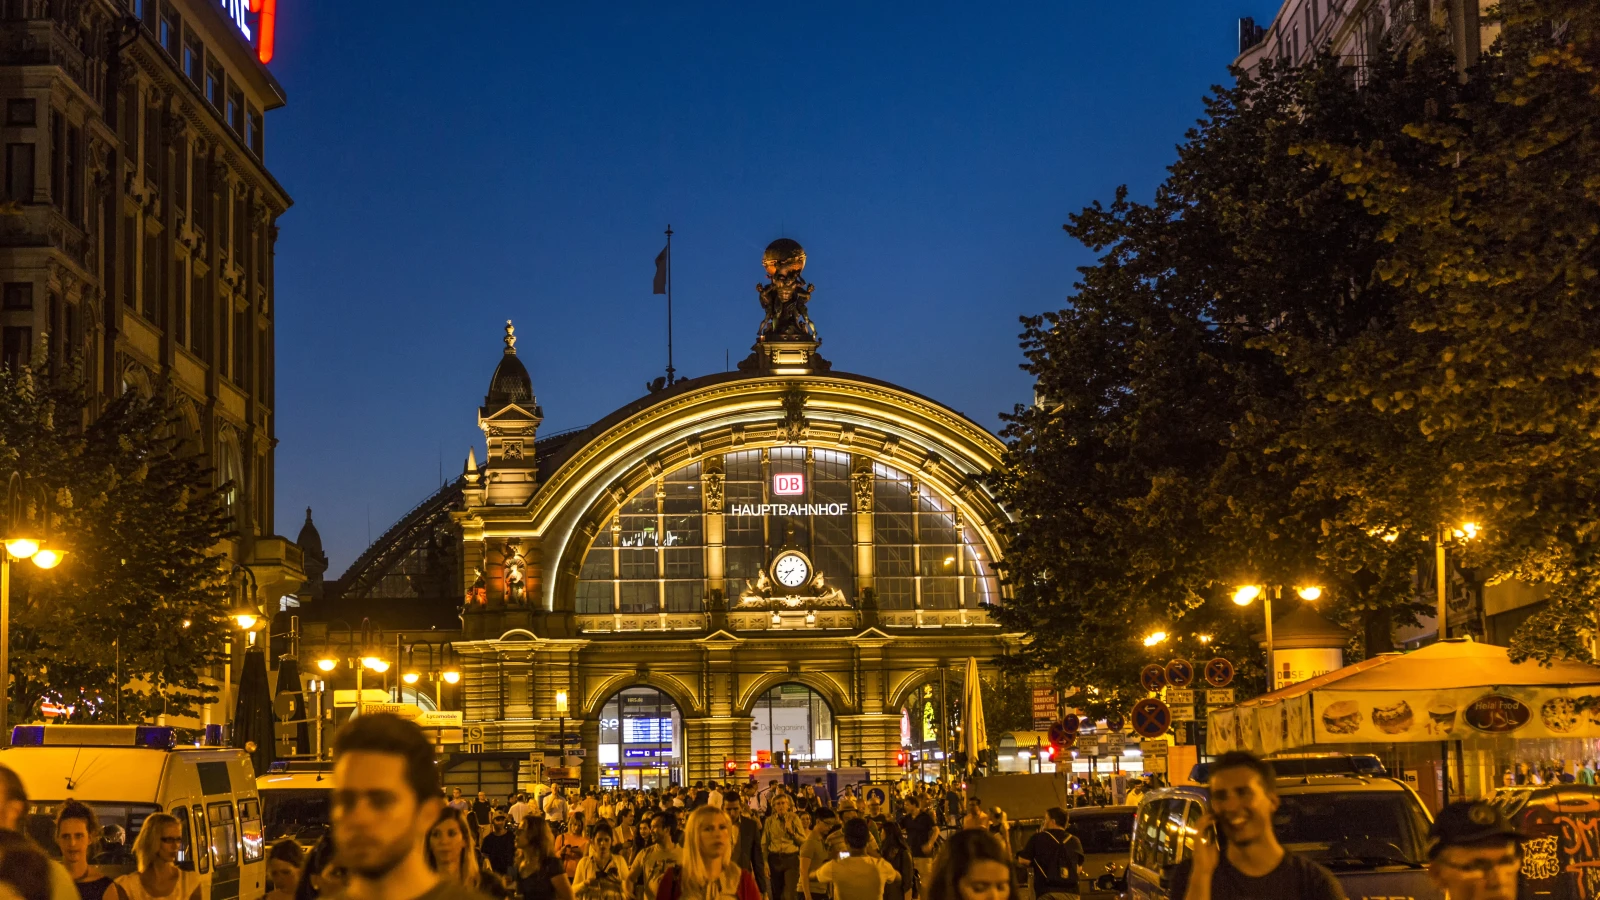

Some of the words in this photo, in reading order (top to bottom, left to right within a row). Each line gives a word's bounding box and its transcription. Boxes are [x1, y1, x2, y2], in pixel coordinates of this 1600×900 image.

[778, 477, 800, 491] DB
[731, 503, 848, 516] HAUPTBAHNHOF
[1499, 700, 1520, 710] Food
